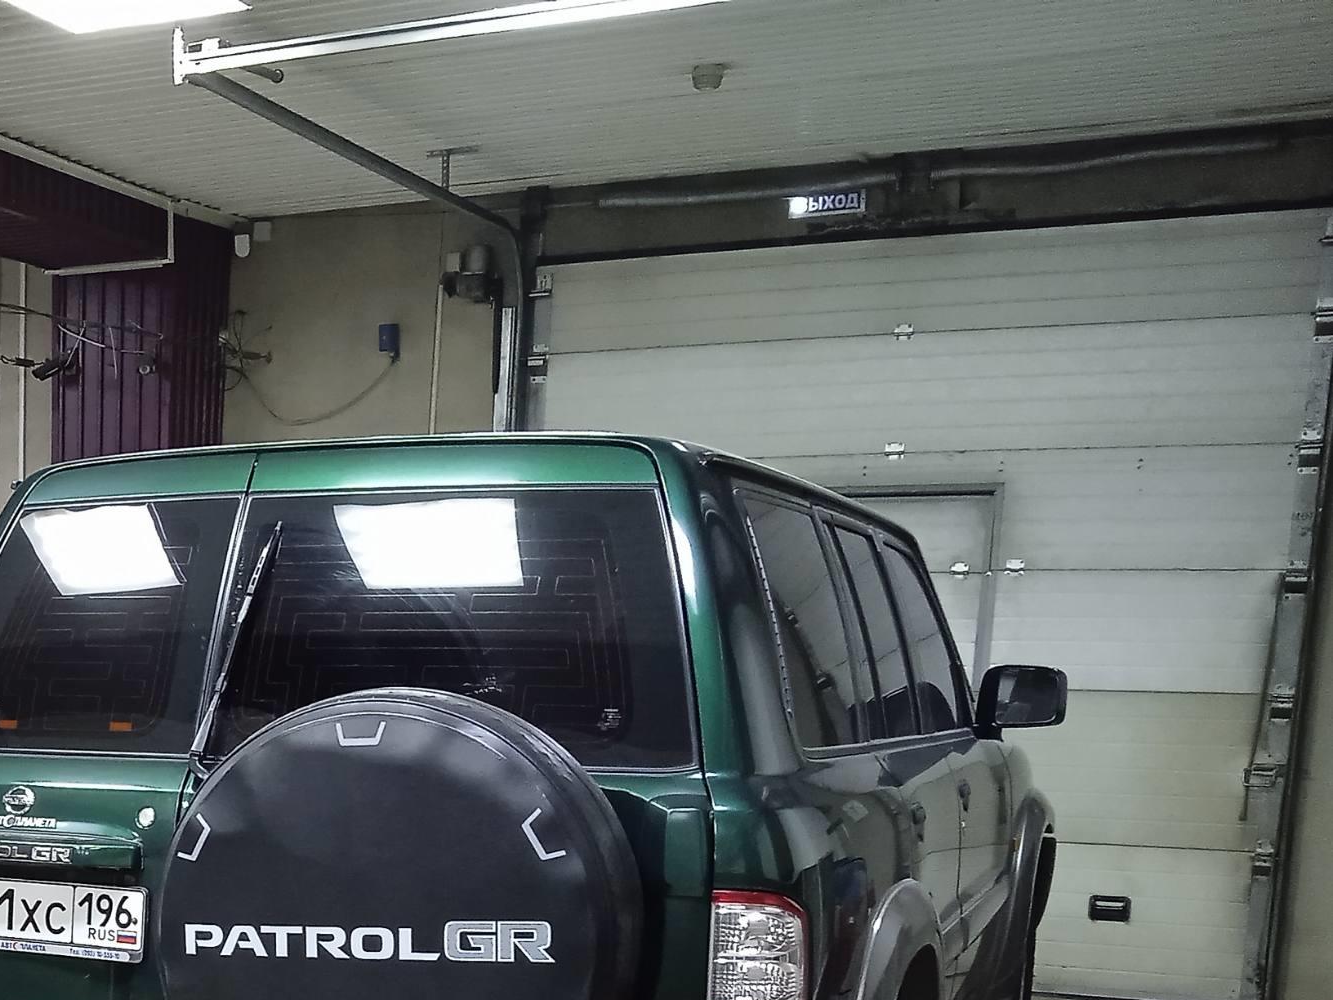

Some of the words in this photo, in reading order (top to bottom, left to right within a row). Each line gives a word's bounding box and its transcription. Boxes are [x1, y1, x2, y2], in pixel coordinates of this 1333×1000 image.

[790, 192, 859, 214] ЫХОД
[78, 892, 132, 929] 196
[87, 927, 116, 942] RUS
[183, 923, 441, 962] PATROL
[443, 919, 556, 963] GR
